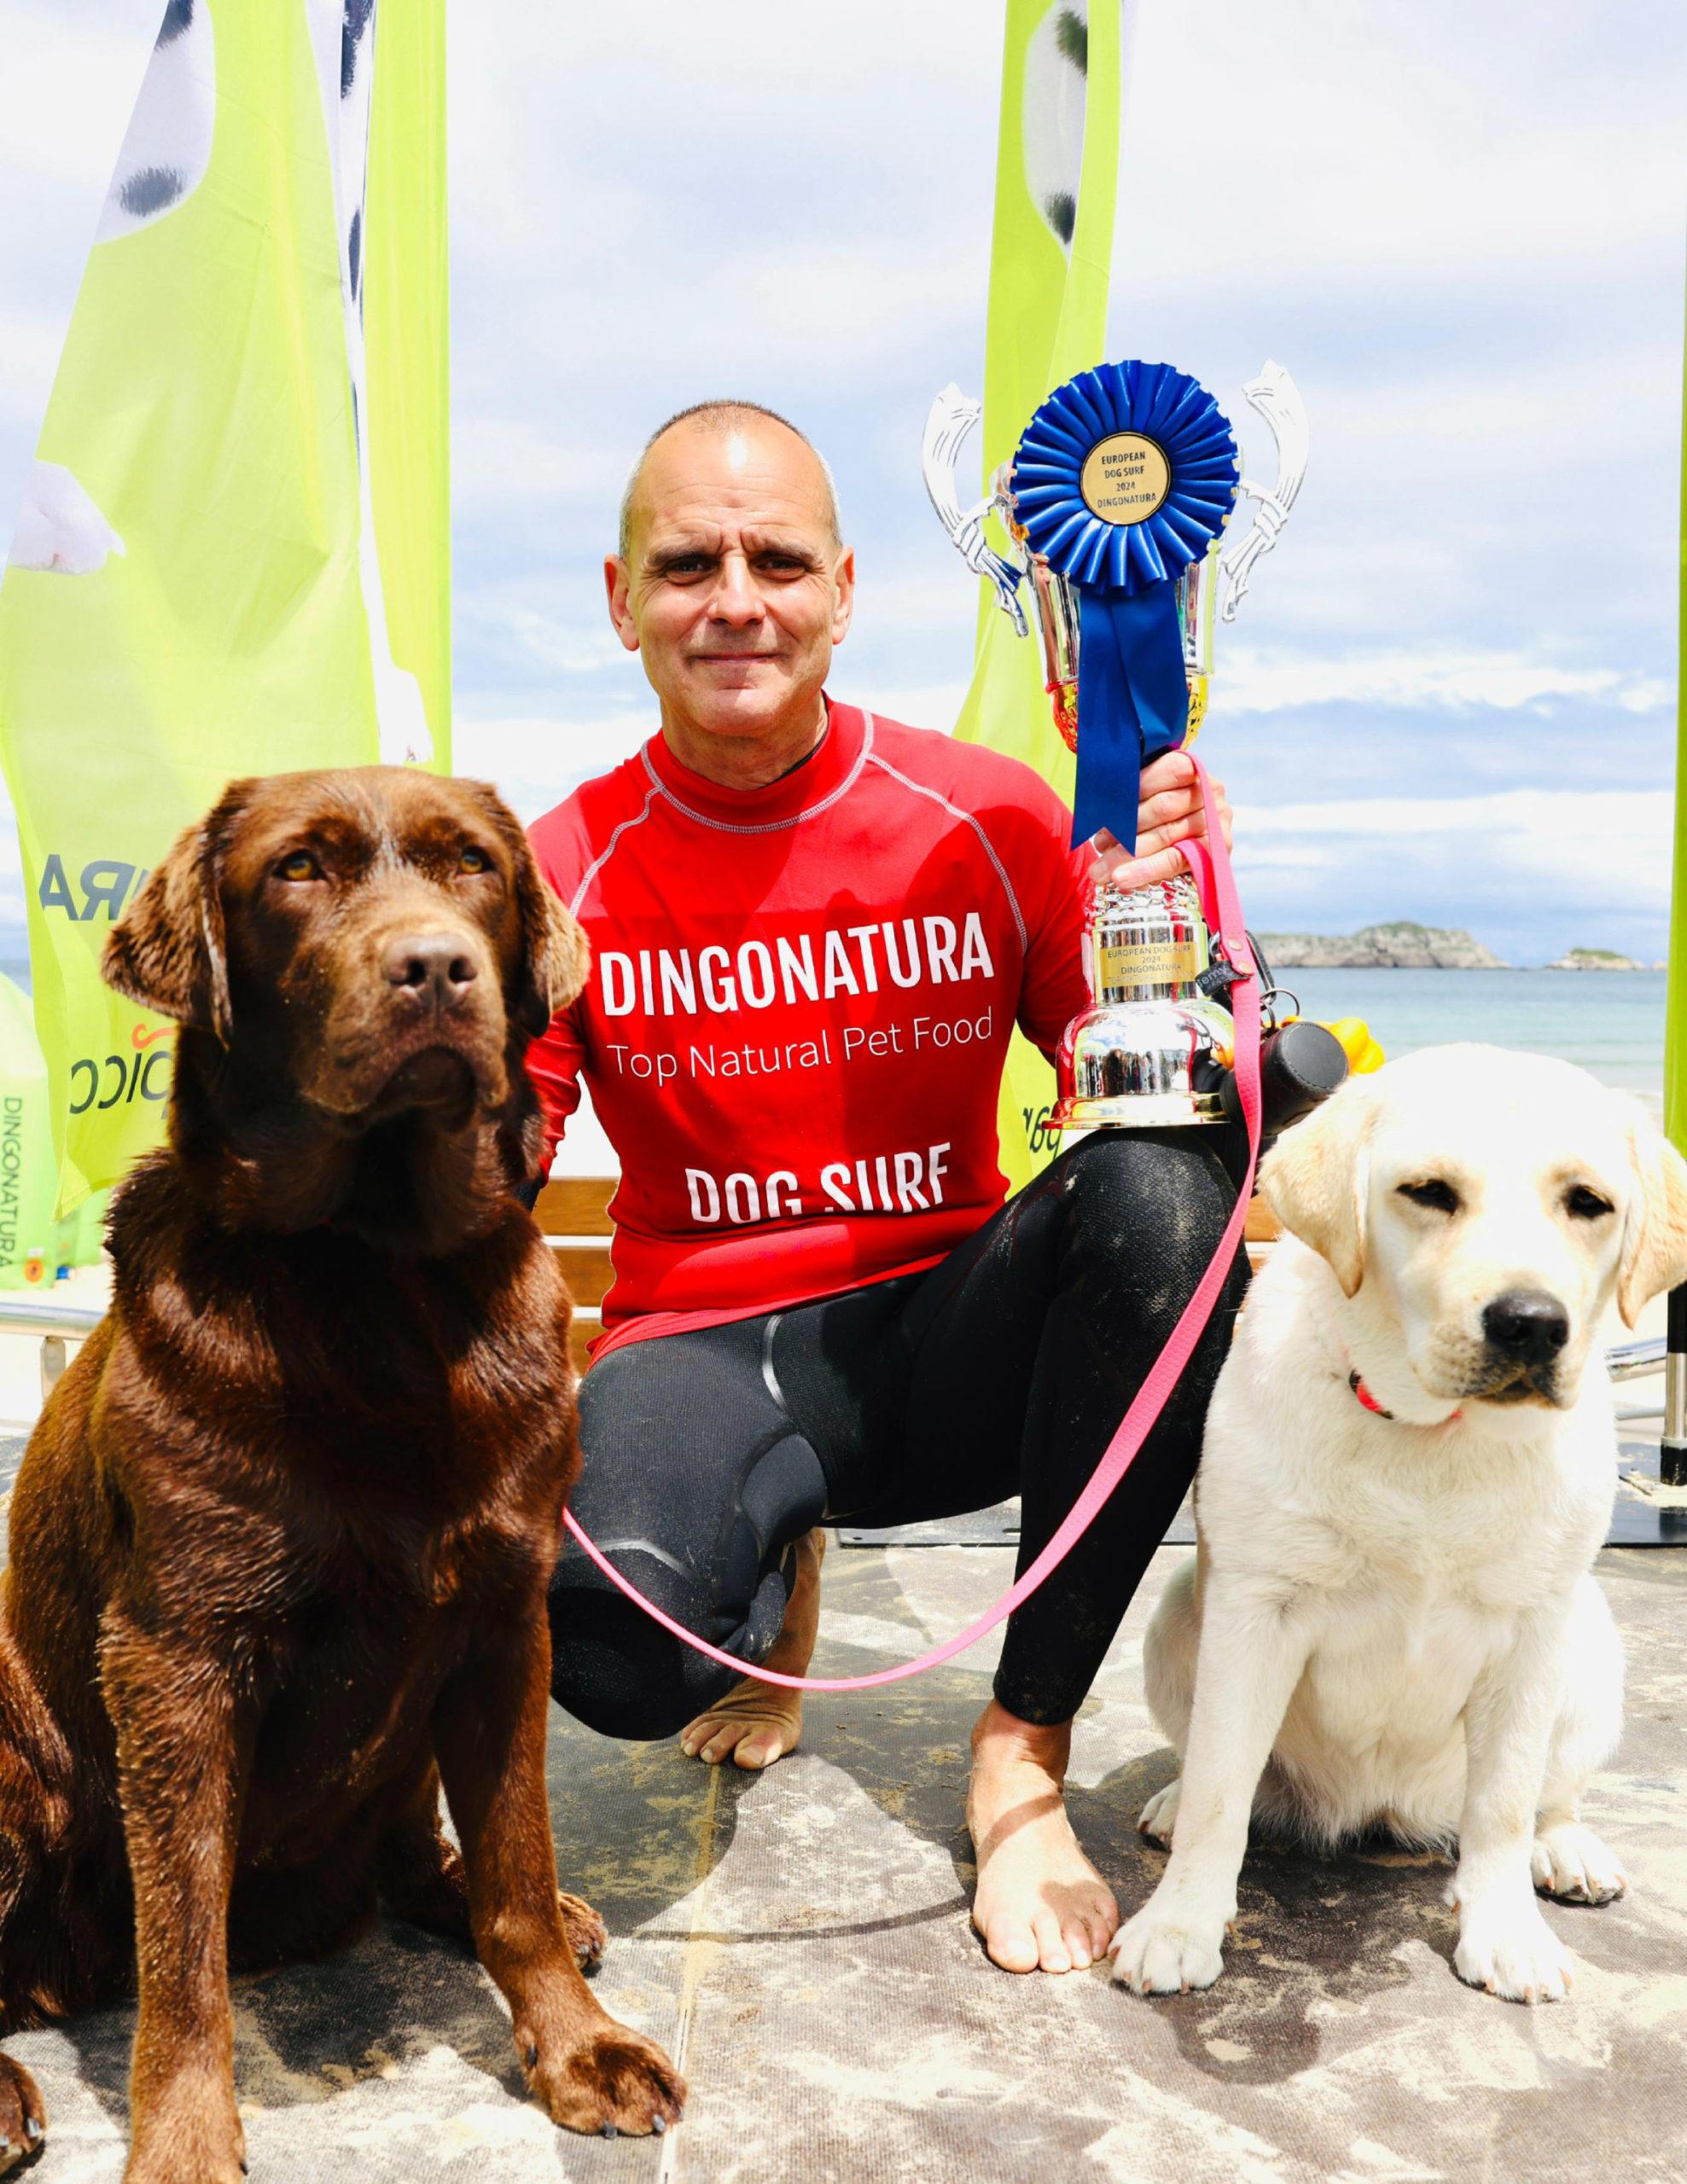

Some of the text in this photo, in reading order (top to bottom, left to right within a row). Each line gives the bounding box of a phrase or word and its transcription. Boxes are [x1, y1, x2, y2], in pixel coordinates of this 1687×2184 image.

[1101, 451, 1146, 465] EUROPEAN
[1104, 466, 1144, 479] DOG SURF
[1116, 481, 1136, 491] 2024
[1097, 493, 1156, 508] DINGONATURA
[1108, 947, 1151, 958] EUROPEAN
[1154, 946, 1172, 955] DOG
[599, 912, 995, 1016] DINGONATURA
[1120, 964, 1182, 974] DINGONATURA
[607, 1006, 993, 1087] Top Natural Pet Food
[0, 1097, 22, 1268] DINGONATURA
[685, 1168, 800, 1224] DOG
